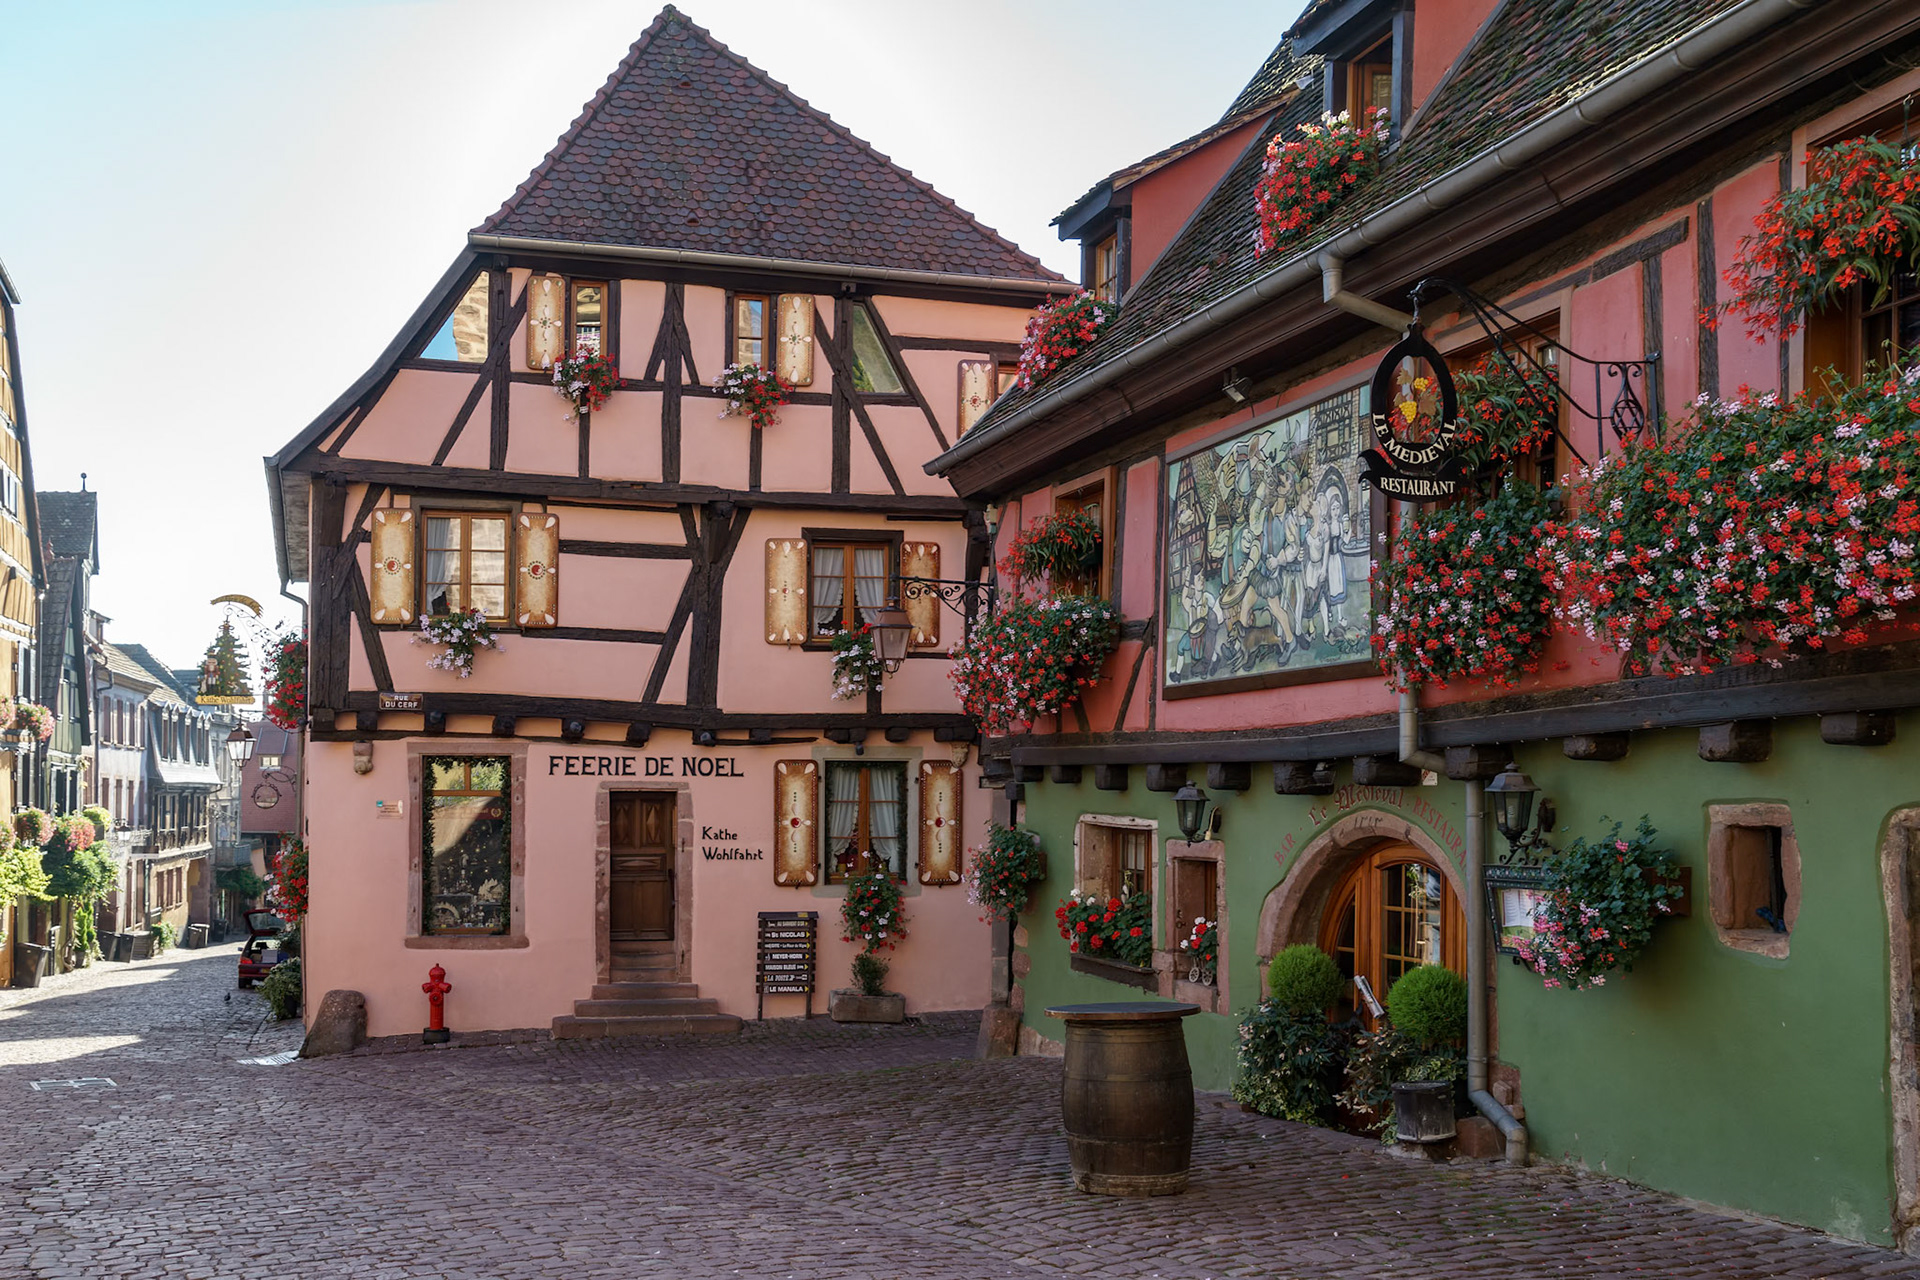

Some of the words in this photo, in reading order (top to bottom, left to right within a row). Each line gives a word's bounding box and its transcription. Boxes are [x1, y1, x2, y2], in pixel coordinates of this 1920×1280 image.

[1372, 413, 1389, 438] LE
[1383, 419, 1457, 464] MEDIEVAL
[1380, 476, 1456, 496] RESTAURANT
[548, 755, 637, 776] FEERIE
[644, 756, 674, 777] DE
[681, 756, 744, 777] NOEL
[702, 826, 738, 841] Kathe
[1274, 833, 1297, 866] BAR
[1308, 805, 1328, 827] Le
[1412, 795, 1467, 876] RESTAURA
[702, 846, 764, 861] Wohlfahrt
